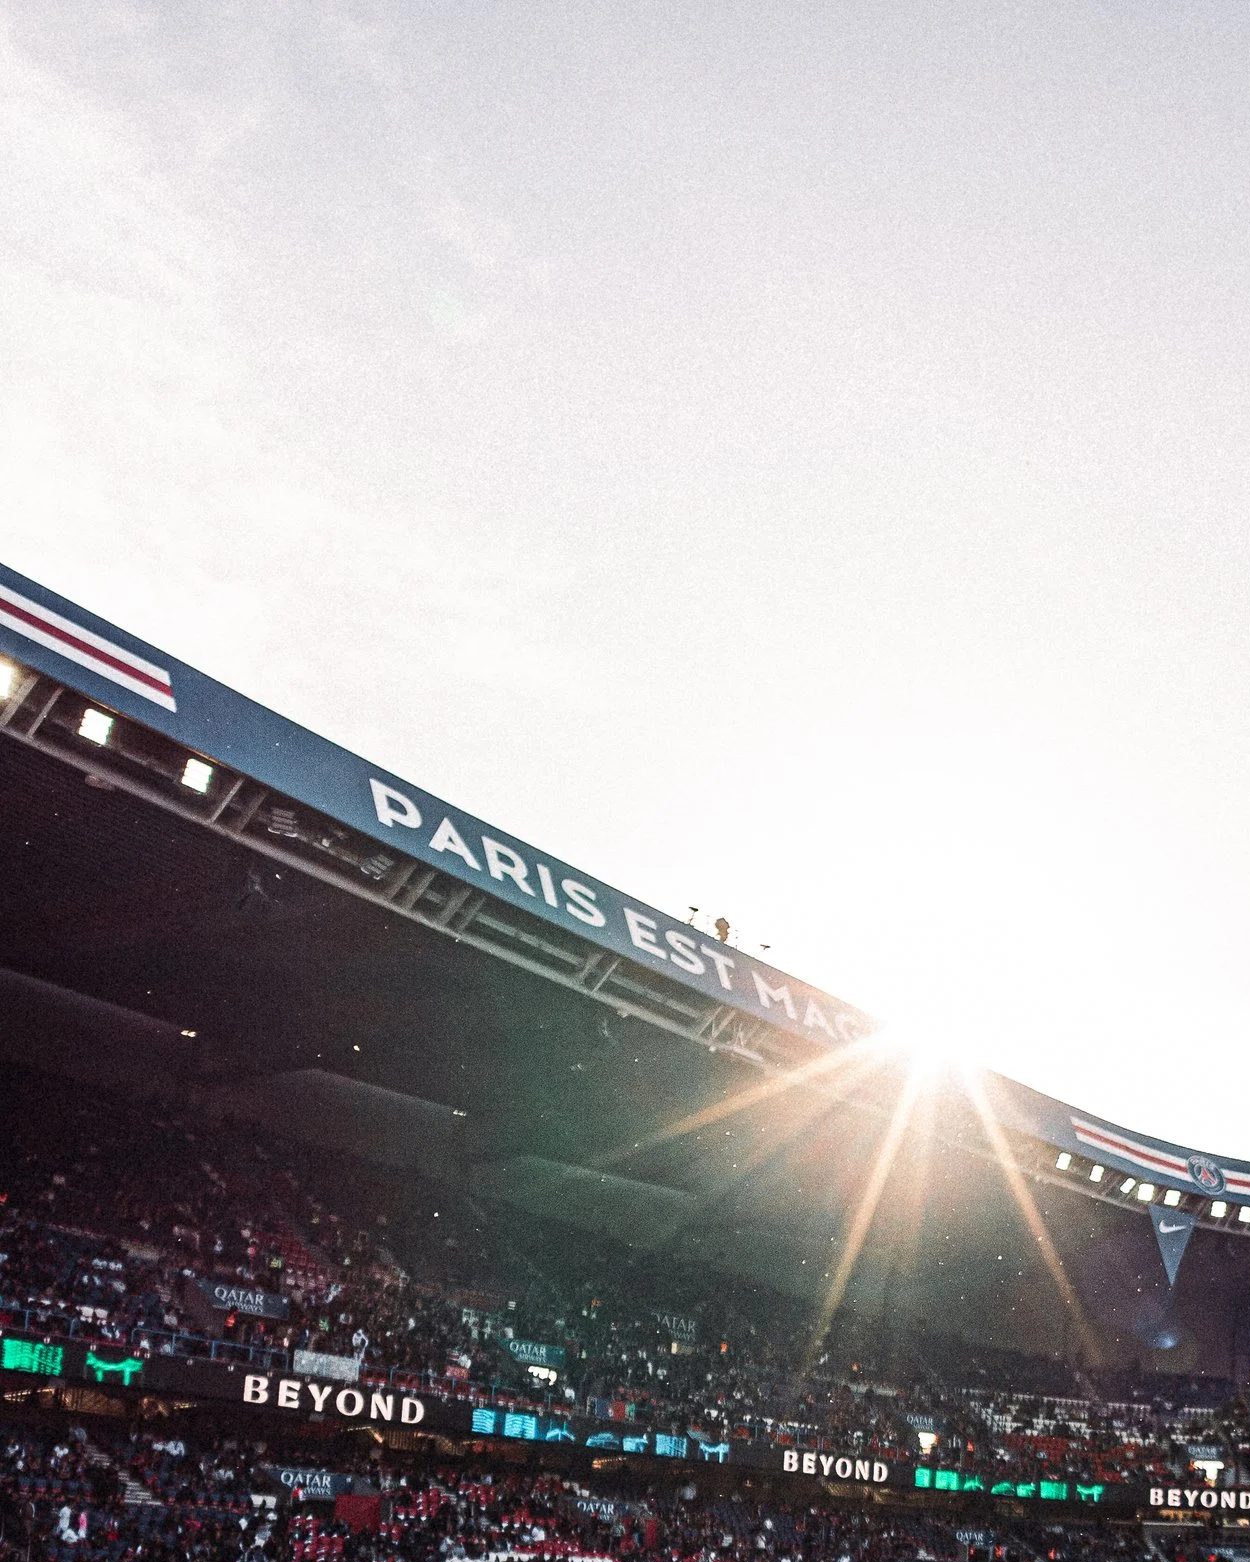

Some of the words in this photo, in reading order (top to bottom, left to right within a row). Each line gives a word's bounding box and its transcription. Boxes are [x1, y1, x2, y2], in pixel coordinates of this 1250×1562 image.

[369, 778, 606, 928] PARIS
[623, 907, 735, 991] EST
[214, 1287, 265, 1306] QATAR
[509, 1341, 547, 1357] QATAR
[244, 1374, 425, 1425] BEYOND
[782, 1450, 889, 1483] BEYOND
[281, 1471, 331, 1488] QATAR
[956, 1531, 984, 1542] QATAR
